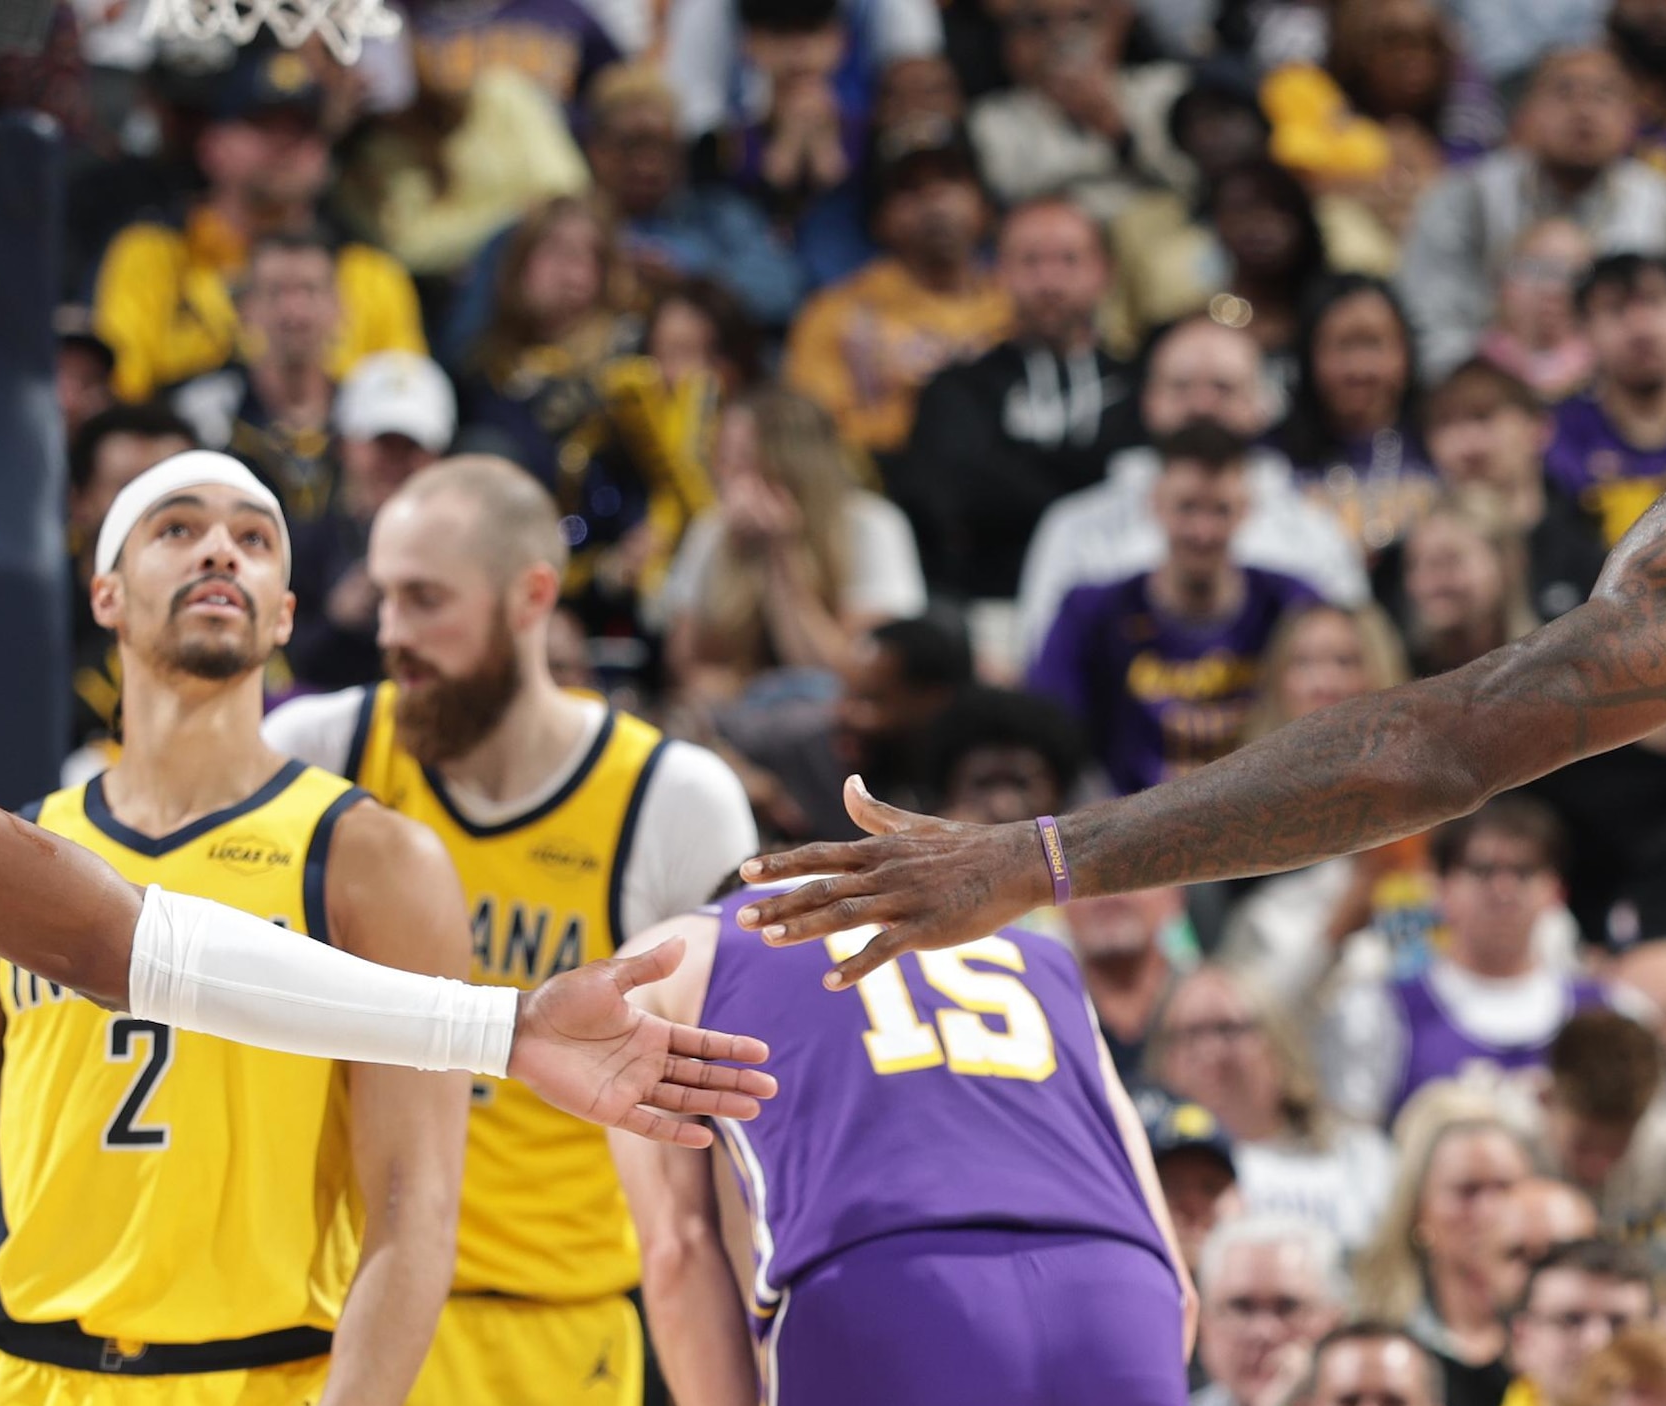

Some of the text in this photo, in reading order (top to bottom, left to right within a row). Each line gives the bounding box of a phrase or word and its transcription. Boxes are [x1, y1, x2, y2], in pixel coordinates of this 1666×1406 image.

[208, 844, 262, 863] LUCAS
[1043, 825, 1065, 874] PROMISE
[823, 922, 1059, 1083] 15
[100, 1016, 173, 1150] 2
